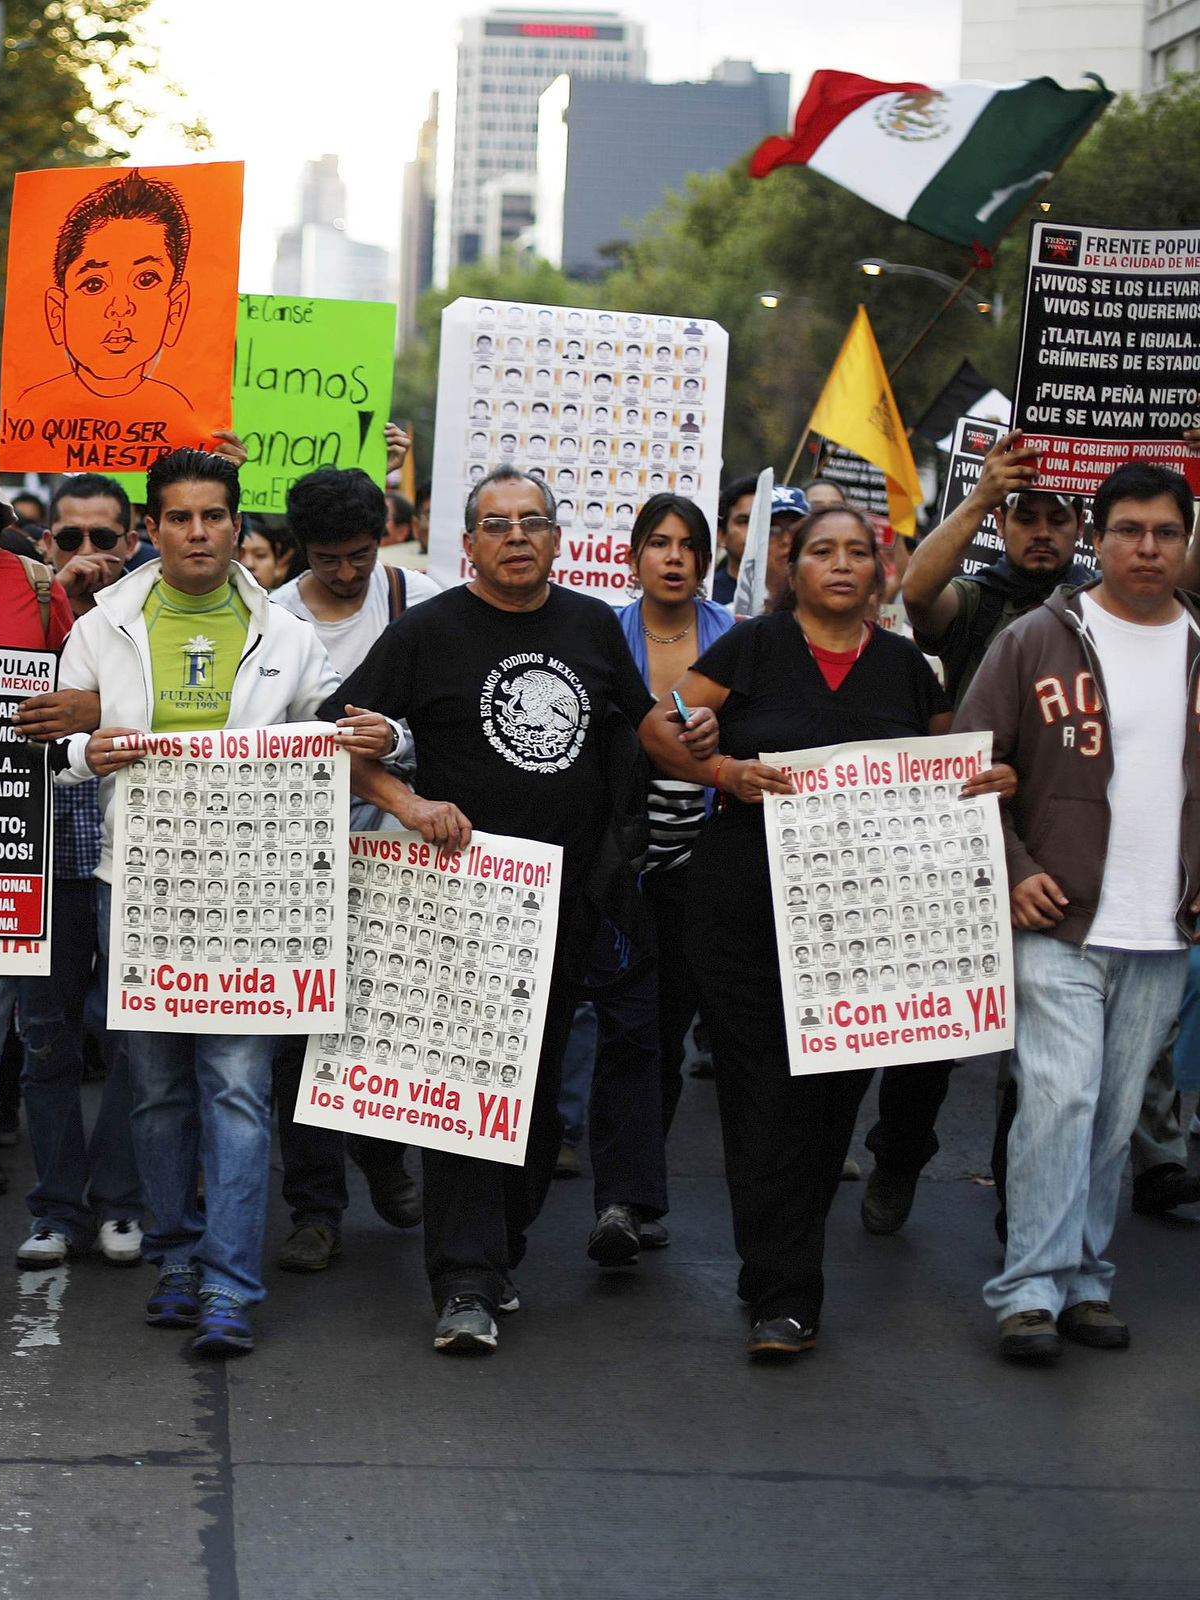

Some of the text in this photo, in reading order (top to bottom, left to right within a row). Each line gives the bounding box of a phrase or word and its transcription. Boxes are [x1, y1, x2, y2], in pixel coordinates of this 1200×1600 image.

[1086, 236, 1148, 254] FRENTE
[1121, 257, 1165, 268] CIUDAD
[1034, 273, 1087, 294] ¡VIVOS
[1044, 297, 1123, 318] VIVOS LOS
[1038, 347, 1118, 370] CRÍMENES
[1101, 385, 1145, 403] PEÑA
[1026, 405, 1144, 427] QUE VAYAN
[42, 418, 121, 448] QUIERO
[120, 421, 169, 443] SER
[1073, 442, 1129, 457] GOBIERNO
[569, 534, 631, 565] vida
[186, 654, 212, 686] F
[1, 677, 49, 692] MEXICO
[480, 652, 591, 717] ESTAMOS JODIDOS MEXICANOS
[196, 702, 218, 710] 1998
[121, 732, 183, 757] Vivos
[190, 735, 212, 758] se
[220, 731, 249, 758] los
[835, 750, 983, 787] se los llevaron!
[408, 841, 430, 867] se
[468, 846, 552, 888] llevaron!
[151, 965, 335, 1013] ¡Con vida YA!
[121, 991, 291, 1019] los queremos,
[827, 985, 1007, 1033] ¡Con vida YA!
[801, 1021, 971, 1054] los queremos,
[310, 1085, 474, 1140] los queremos,
[341, 1064, 522, 1143] ¡Con vida YA!
